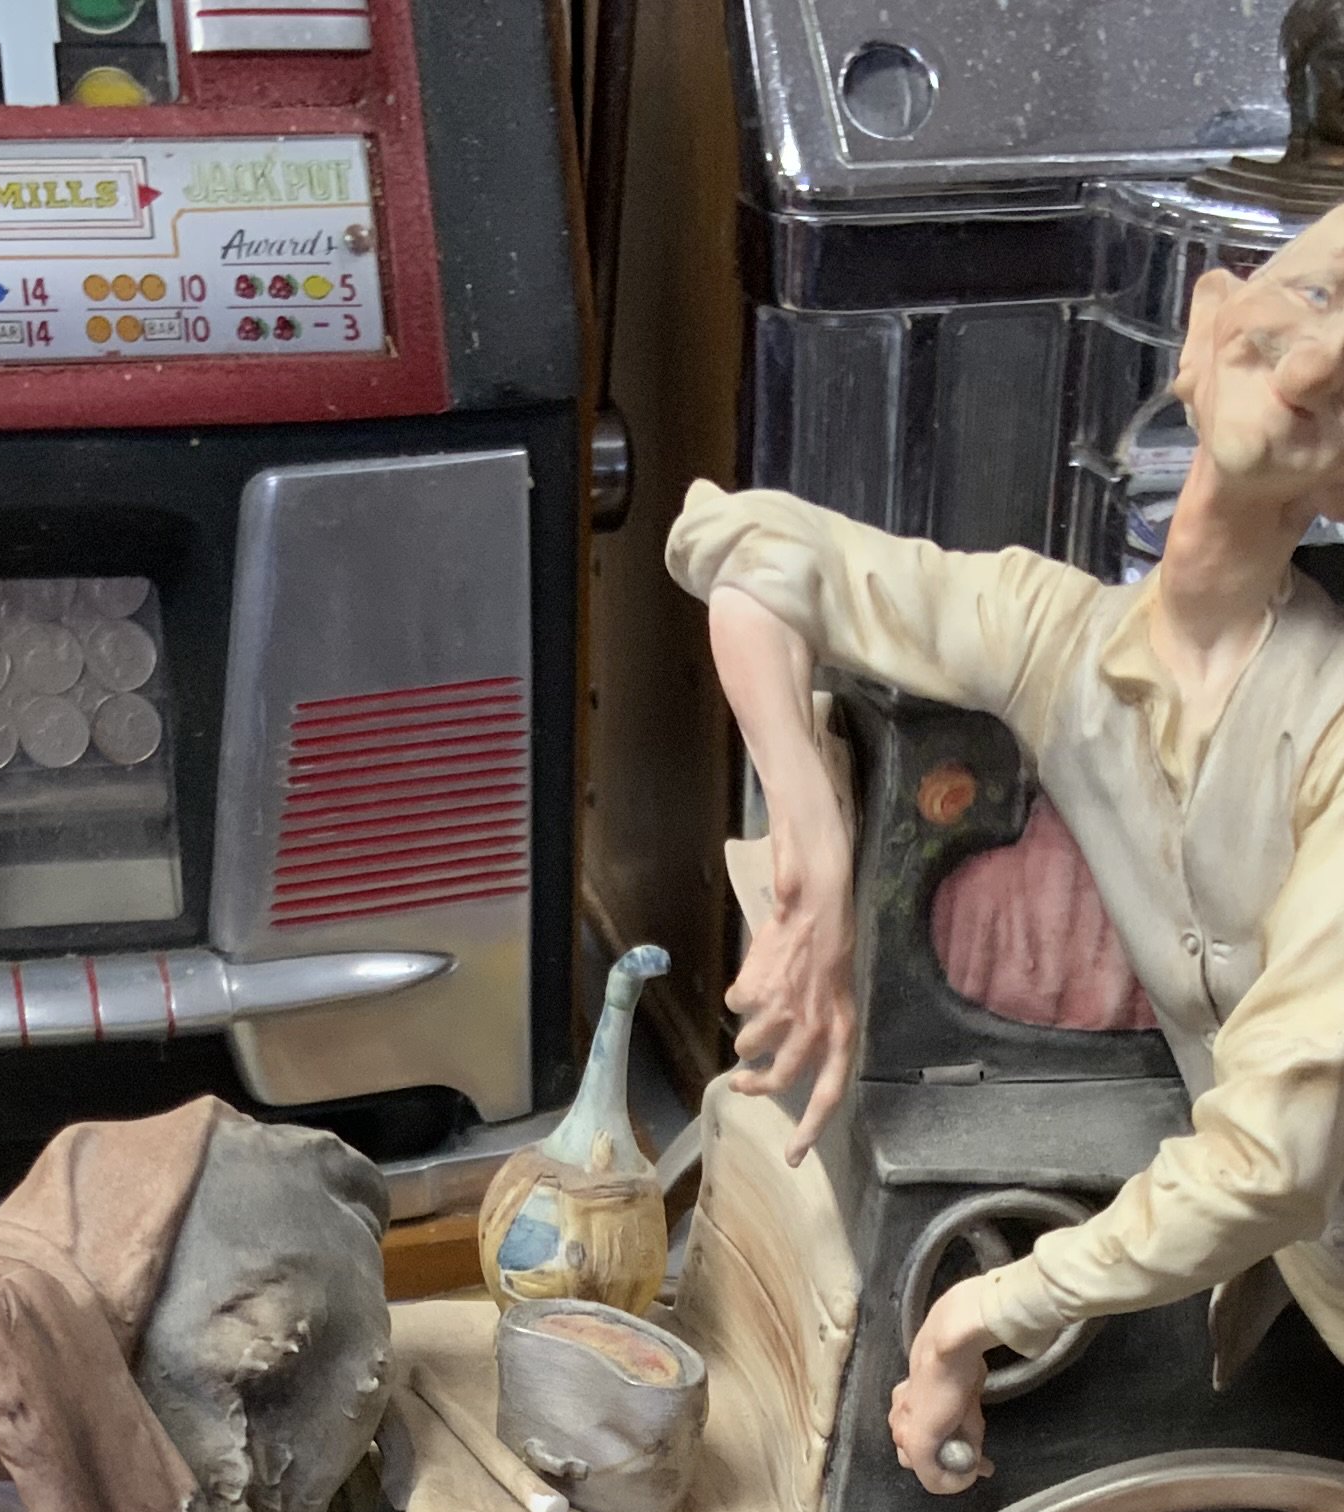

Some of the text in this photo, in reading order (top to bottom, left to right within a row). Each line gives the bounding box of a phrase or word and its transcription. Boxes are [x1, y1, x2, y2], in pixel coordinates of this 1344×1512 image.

[220, 229, 338, 261] Awards
[21, 277, 49, 306] 14
[180, 274, 207, 303] 10
[339, 274, 356, 302] 5
[25, 320, 54, 347] 14
[183, 315, 211, 343] 10
[343, 314, 361, 342] 3
